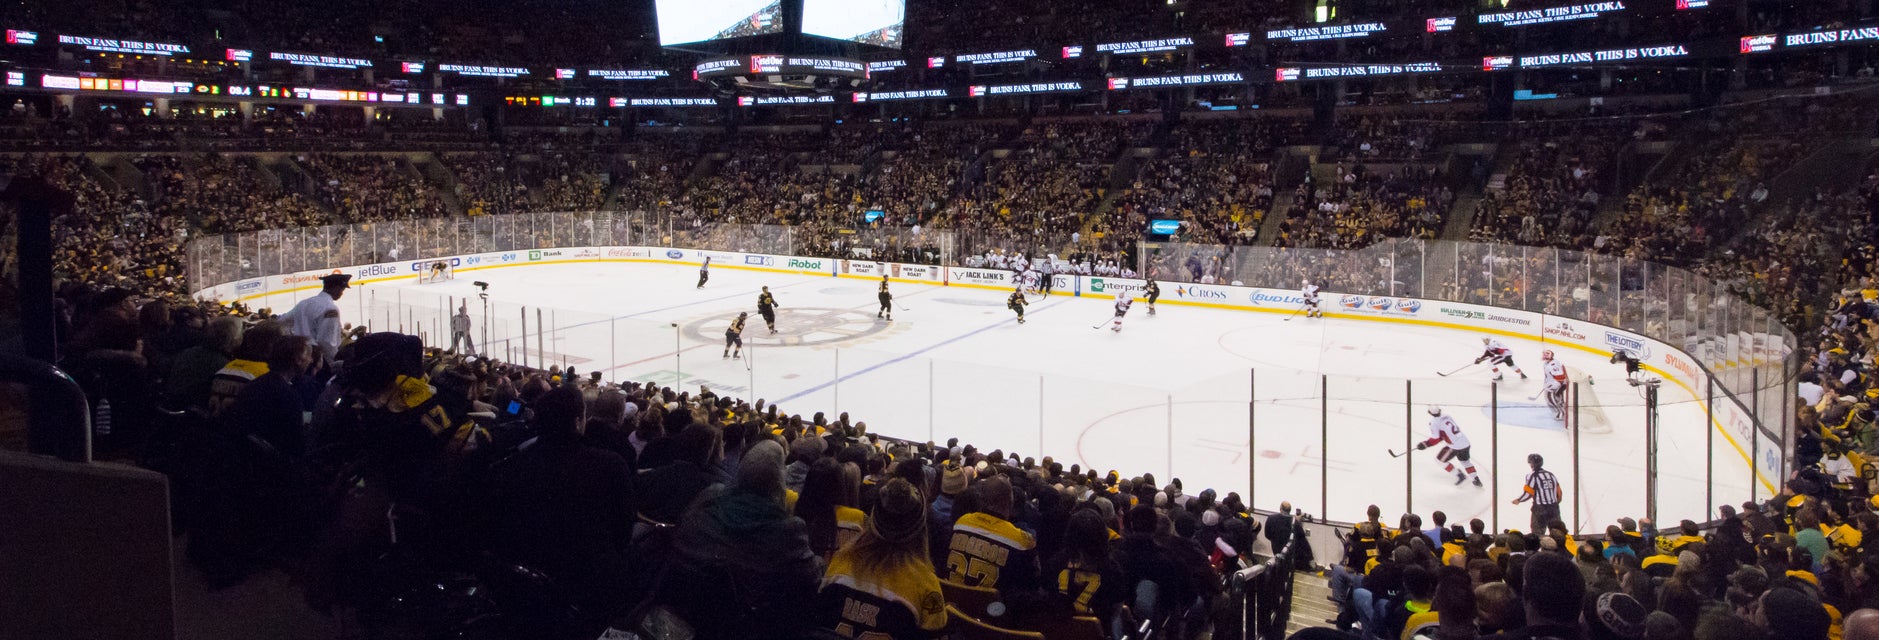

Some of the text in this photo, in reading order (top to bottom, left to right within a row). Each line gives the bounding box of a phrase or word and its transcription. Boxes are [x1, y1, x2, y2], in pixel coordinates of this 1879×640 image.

[1478, 13, 1514, 23] BRUINS
[1545, 8, 1569, 17] THIS
[1571, 6, 1582, 14] IS
[1584, 1, 1625, 12] VODKA.
[1268, 30, 1296, 39] BRUINS
[1322, 26, 1342, 34] THIS
[1353, 23, 1387, 32] VODKA.
[1787, 30, 1837, 45] BRUINS
[59, 35, 92, 46] BRUINS
[121, 40, 144, 49] THIS
[155, 43, 190, 52] VODKA.
[271, 52, 298, 60] BRUINS
[770, 56, 783, 65] One
[1521, 55, 1560, 66] BRUINS
[1562, 52, 1593, 63] FANS,
[1595, 50, 1623, 60] THIS
[1626, 49, 1637, 58] IS
[1641, 46, 1688, 57] VODKA.
[1307, 68, 1339, 77] BRUINS
[1368, 65, 1390, 74] THIS
[1392, 64, 1402, 73] IS
[1405, 63, 1442, 72] VODKA.
[1133, 78, 1160, 86] BRUINS
[1183, 75, 1201, 84] THIS
[1212, 73, 1243, 81] VODKA.
[576, 98, 595, 106] 3:32
[788, 259, 821, 269] iRobot
[358, 264, 396, 279] jetBlue
[1096, 280, 1145, 292] enterpris
[1189, 286, 1227, 299] CROSS
[1283, 296, 1322, 304] LIGT
[1488, 315, 1530, 325] BRIDGESTONE
[1544, 327, 1585, 341] SHOP.NHL.COM
[1607, 334, 1642, 350] THE LOTTERY
